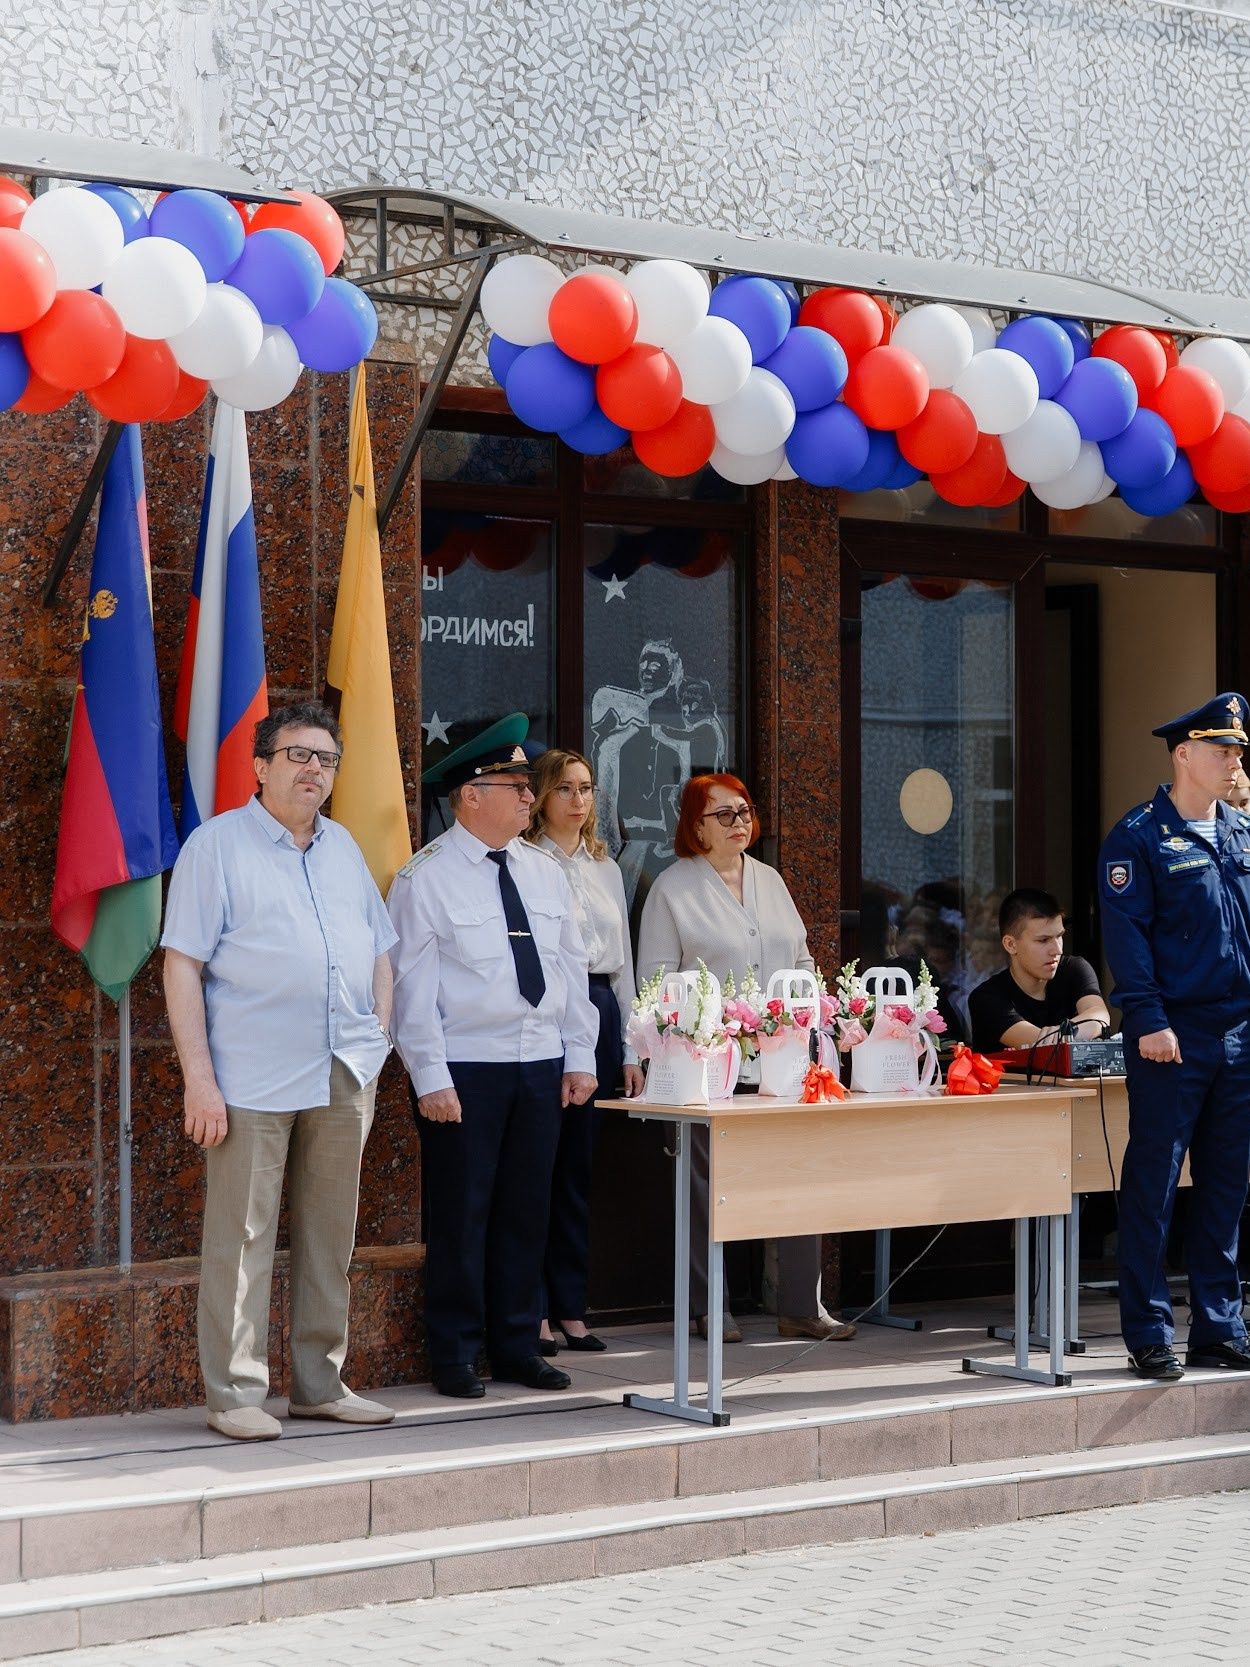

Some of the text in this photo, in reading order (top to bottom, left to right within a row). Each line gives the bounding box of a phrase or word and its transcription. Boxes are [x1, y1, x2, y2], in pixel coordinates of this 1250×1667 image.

[422, 565, 443, 591] Ы
[421, 604, 535, 647] РДИМСЯ!
[882, 1061, 911, 1069] FLOWER
